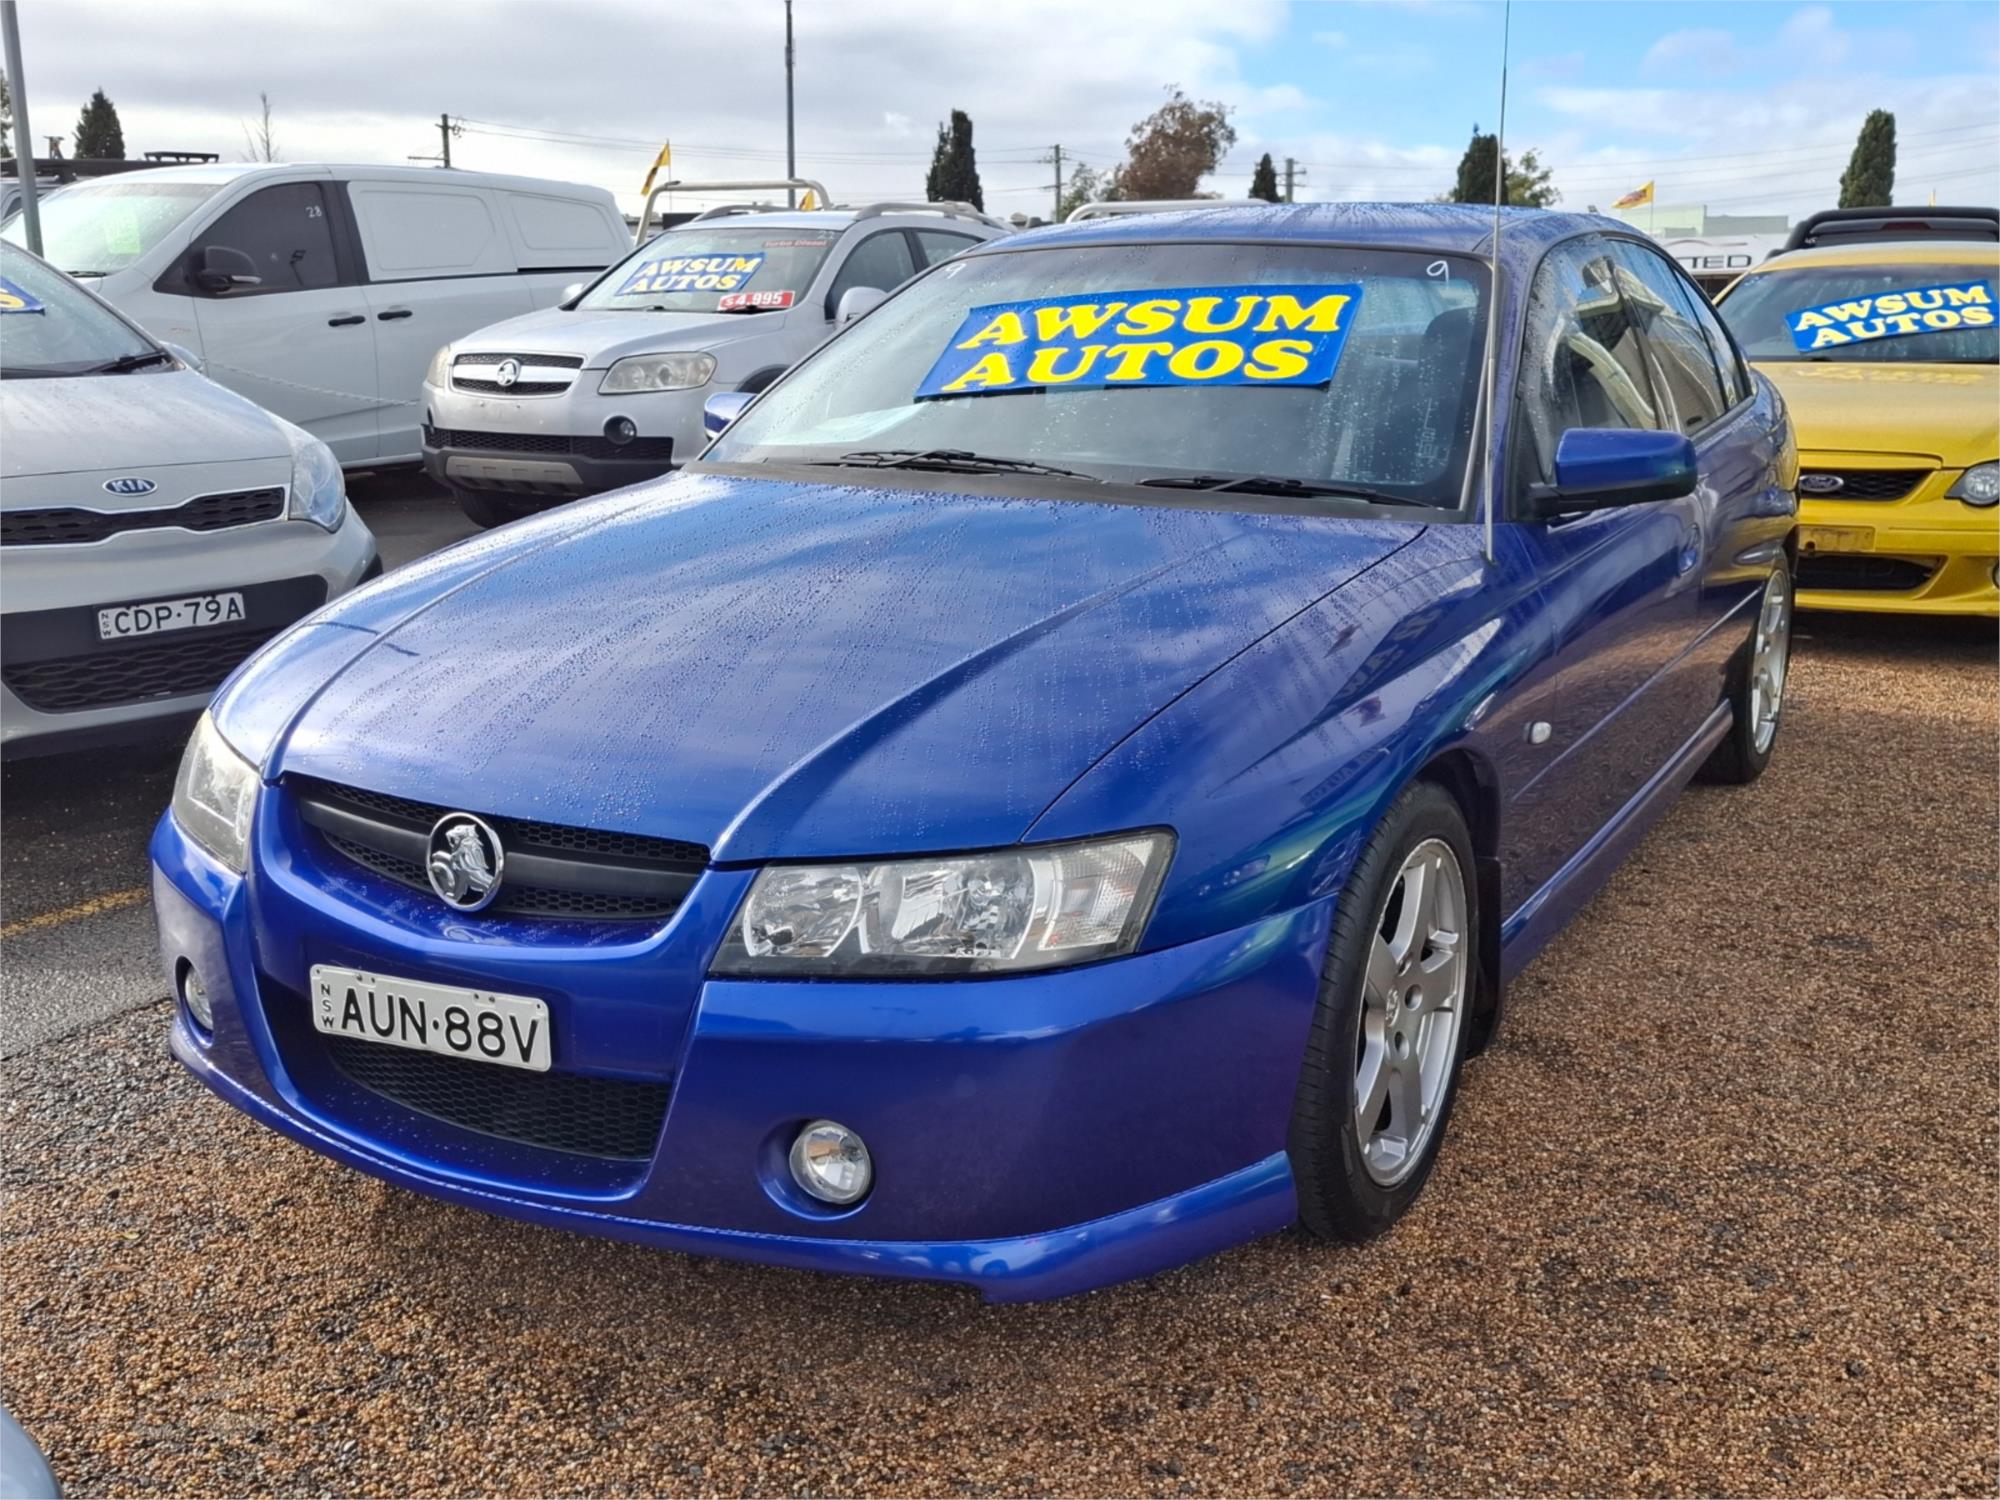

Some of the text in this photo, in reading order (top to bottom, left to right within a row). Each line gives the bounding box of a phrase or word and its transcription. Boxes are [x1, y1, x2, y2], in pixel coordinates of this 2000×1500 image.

[635, 257, 762, 278] AWSUM
[1426, 260, 1449, 283] 9
[622, 274, 742, 294] AUTOS
[955, 295, 1351, 350] AWSUM
[1794, 285, 1992, 332] AWSUM
[1810, 306, 1994, 348] AUTOS
[942, 340, 1314, 391] AUTOS
[111, 480, 151, 492] KIA
